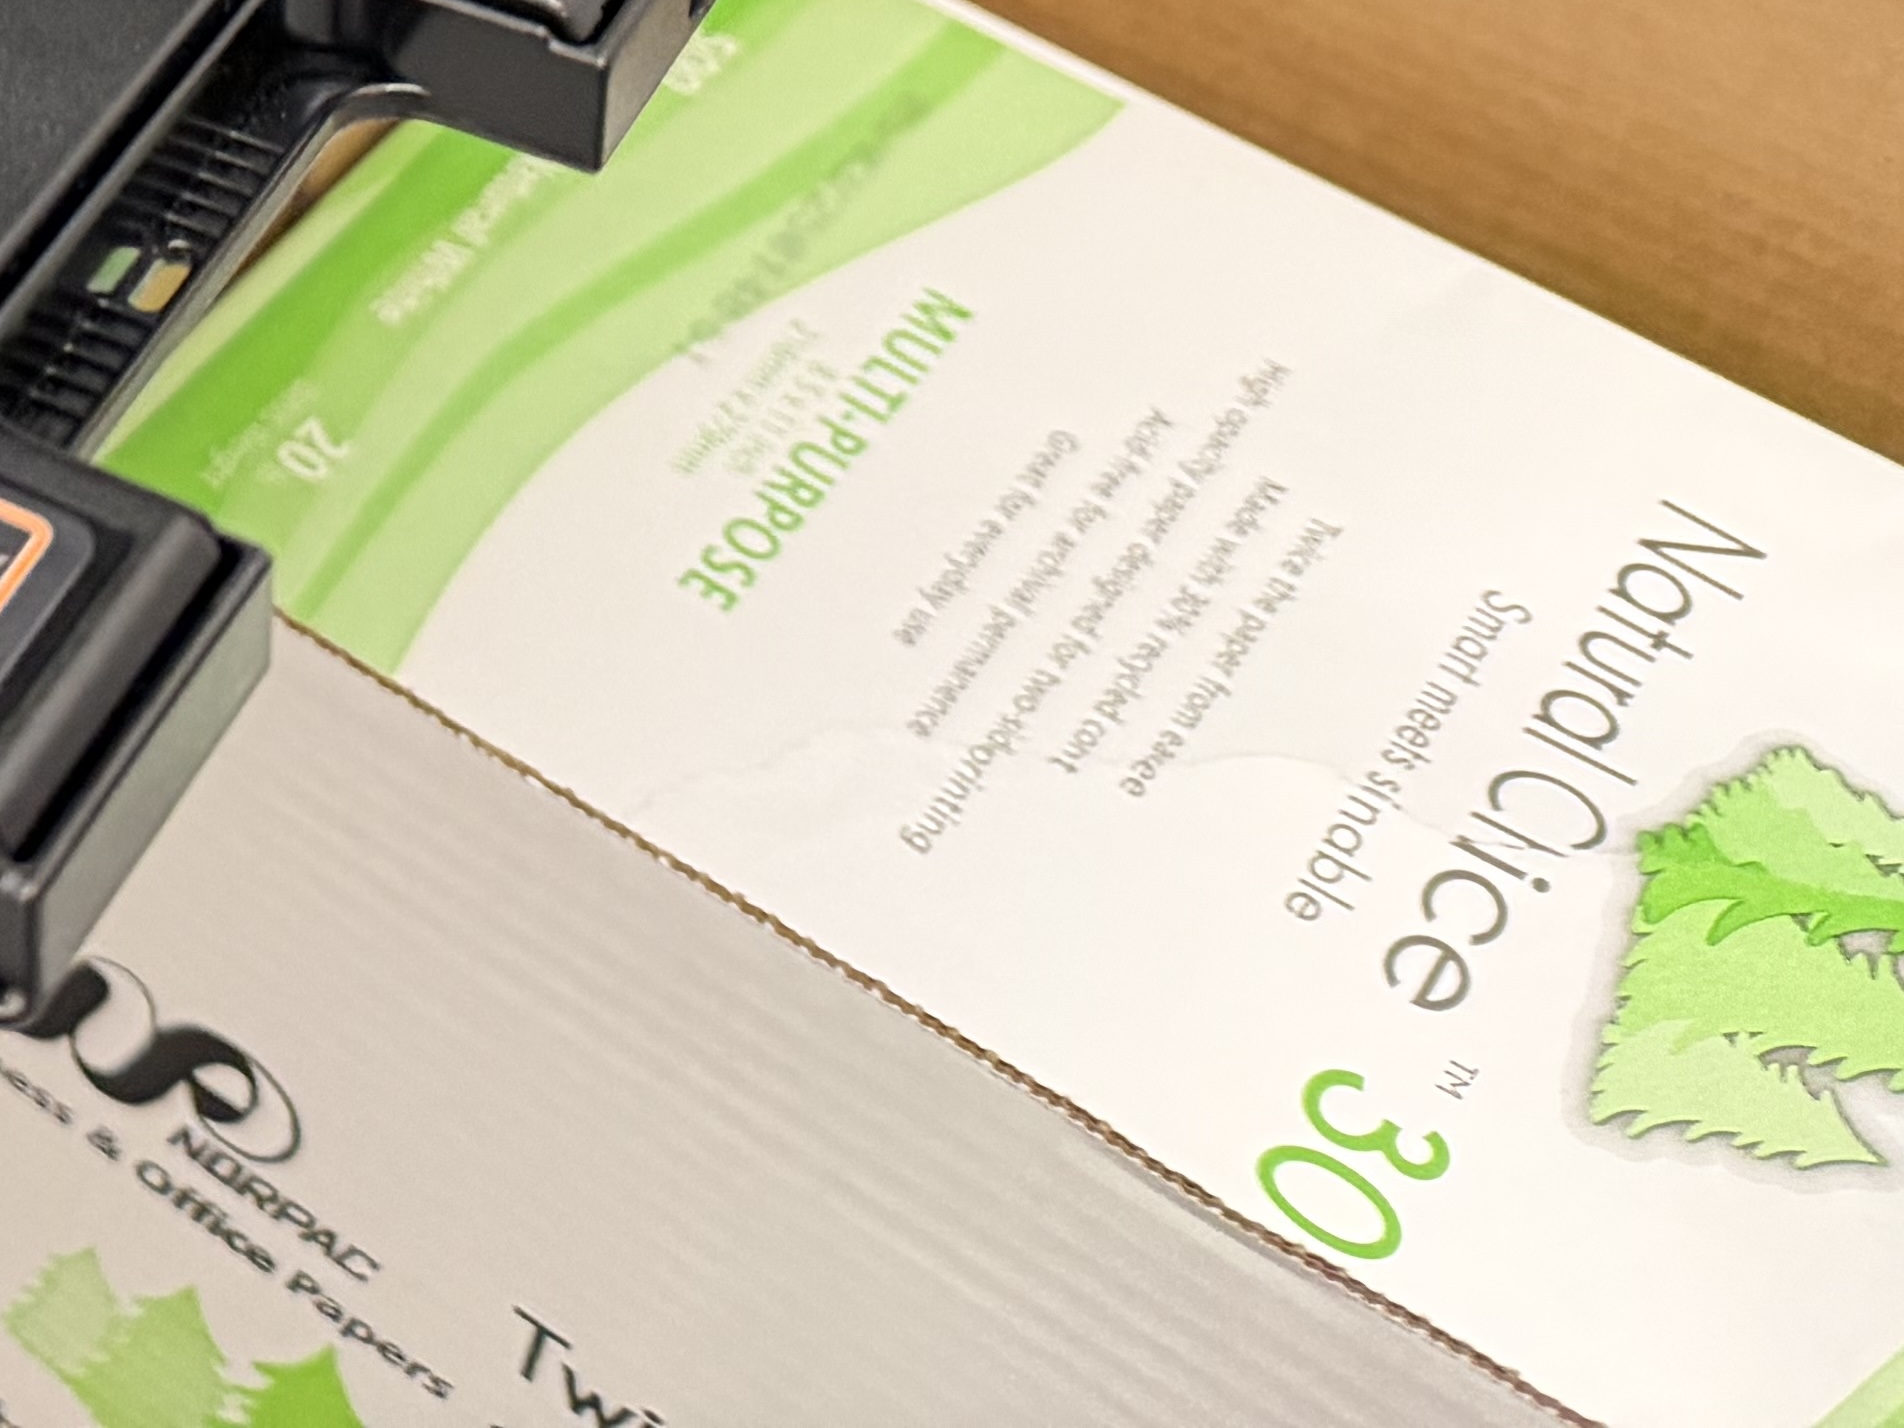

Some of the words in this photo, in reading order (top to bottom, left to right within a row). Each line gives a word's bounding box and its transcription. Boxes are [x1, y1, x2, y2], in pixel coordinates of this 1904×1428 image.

[281, 410, 353, 487] 20
[677, 289, 973, 612] MULTI-PURPOSE
[996, 490, 1037, 521] for
[1069, 501, 1109, 534] for
[1226, 478, 1288, 537] Made
[918, 520, 1004, 610] everyday
[1190, 538, 1238, 585] with
[1280, 518, 1343, 577] Twice
[893, 609, 933, 647] use
[1071, 543, 1154, 640] designed
[1253, 577, 1297, 614] the
[907, 606, 1017, 738] permanence
[1048, 635, 1092, 670] for
[1212, 610, 1266, 678] paper
[1438, 590, 1532, 687] Smart
[1093, 634, 1169, 725] recycled
[1172, 677, 1232, 730] from
[1381, 682, 1458, 770] meets
[1256, 1069, 1450, 1260] 30
[167, 1126, 384, 1285] NORPAC
[87, 1129, 123, 1164] &
[134, 1158, 276, 1273] Office
[287, 1270, 455, 1400] Papers
